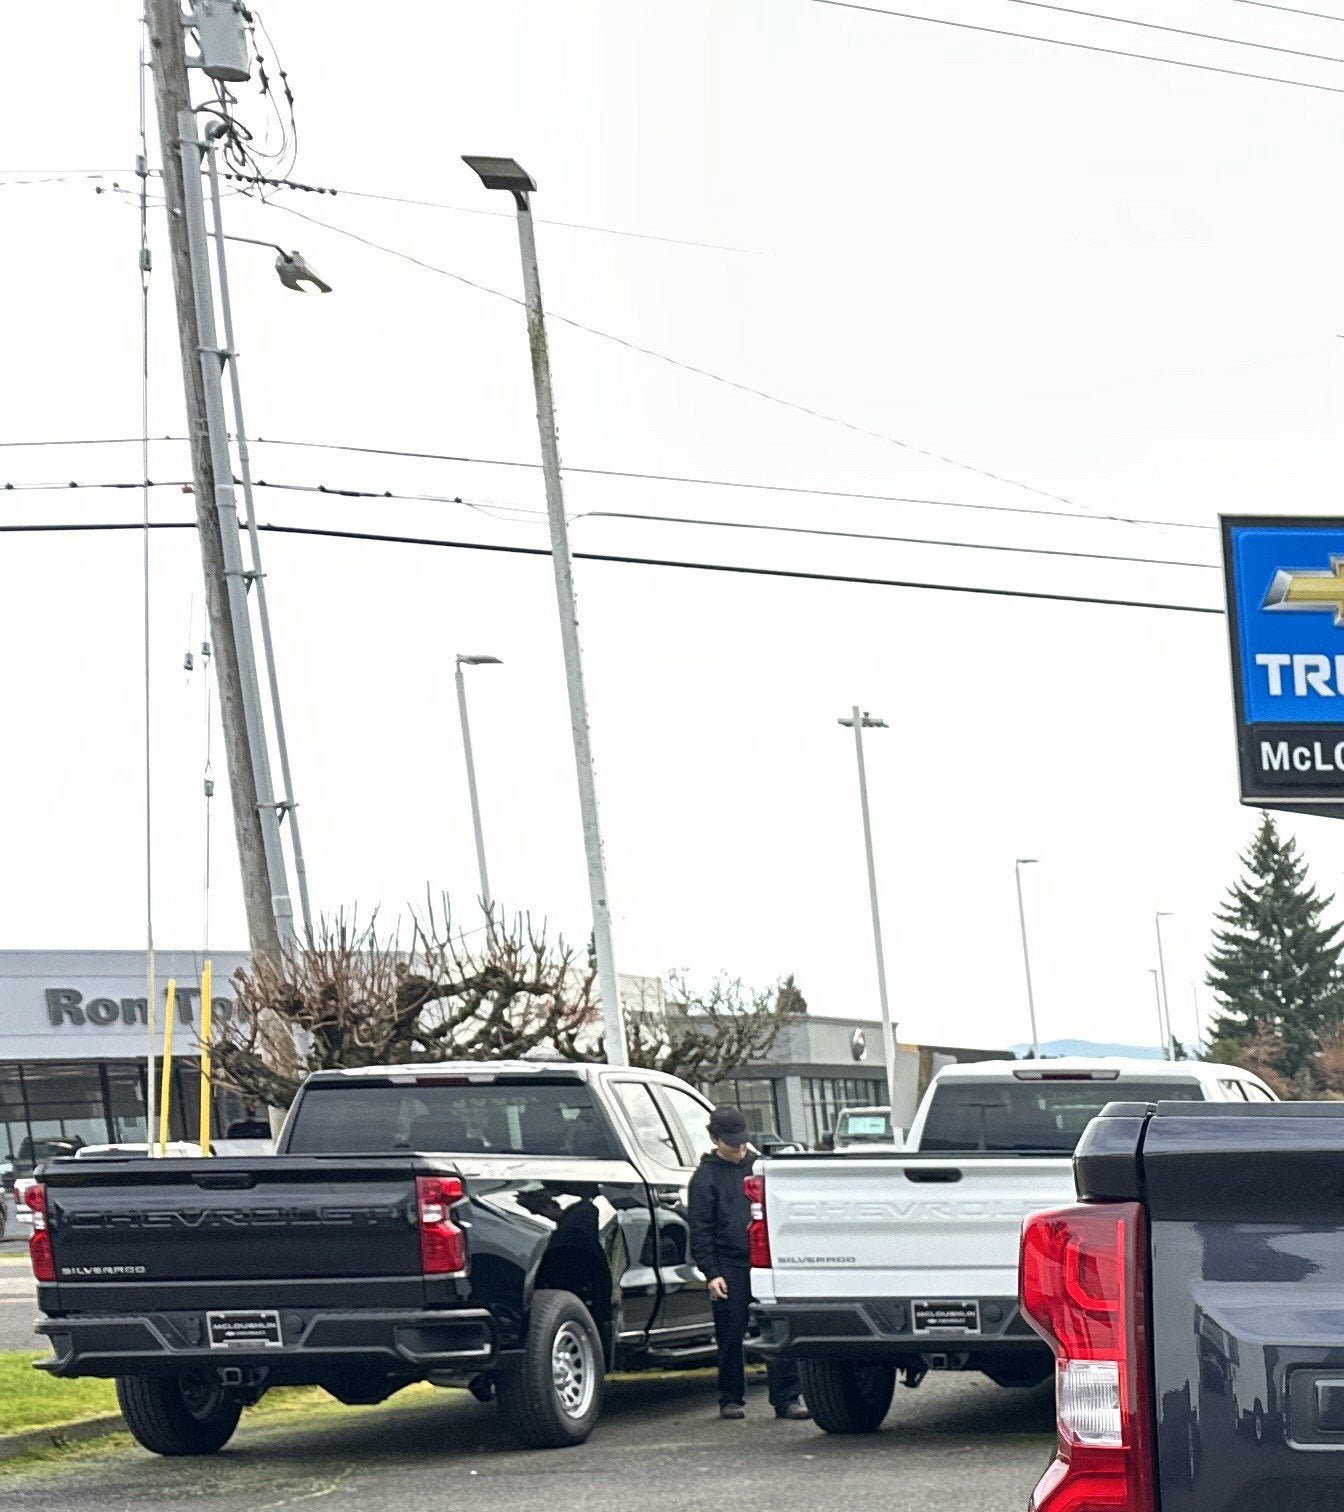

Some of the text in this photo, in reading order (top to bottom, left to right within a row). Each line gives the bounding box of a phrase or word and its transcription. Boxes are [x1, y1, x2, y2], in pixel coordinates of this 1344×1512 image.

[44, 986, 149, 1026] Ron
[71, 1207, 398, 1229] CHEVROLET
[787, 1201, 1070, 1221] CHEVROL
[61, 1265, 146, 1275] SILVERADO
